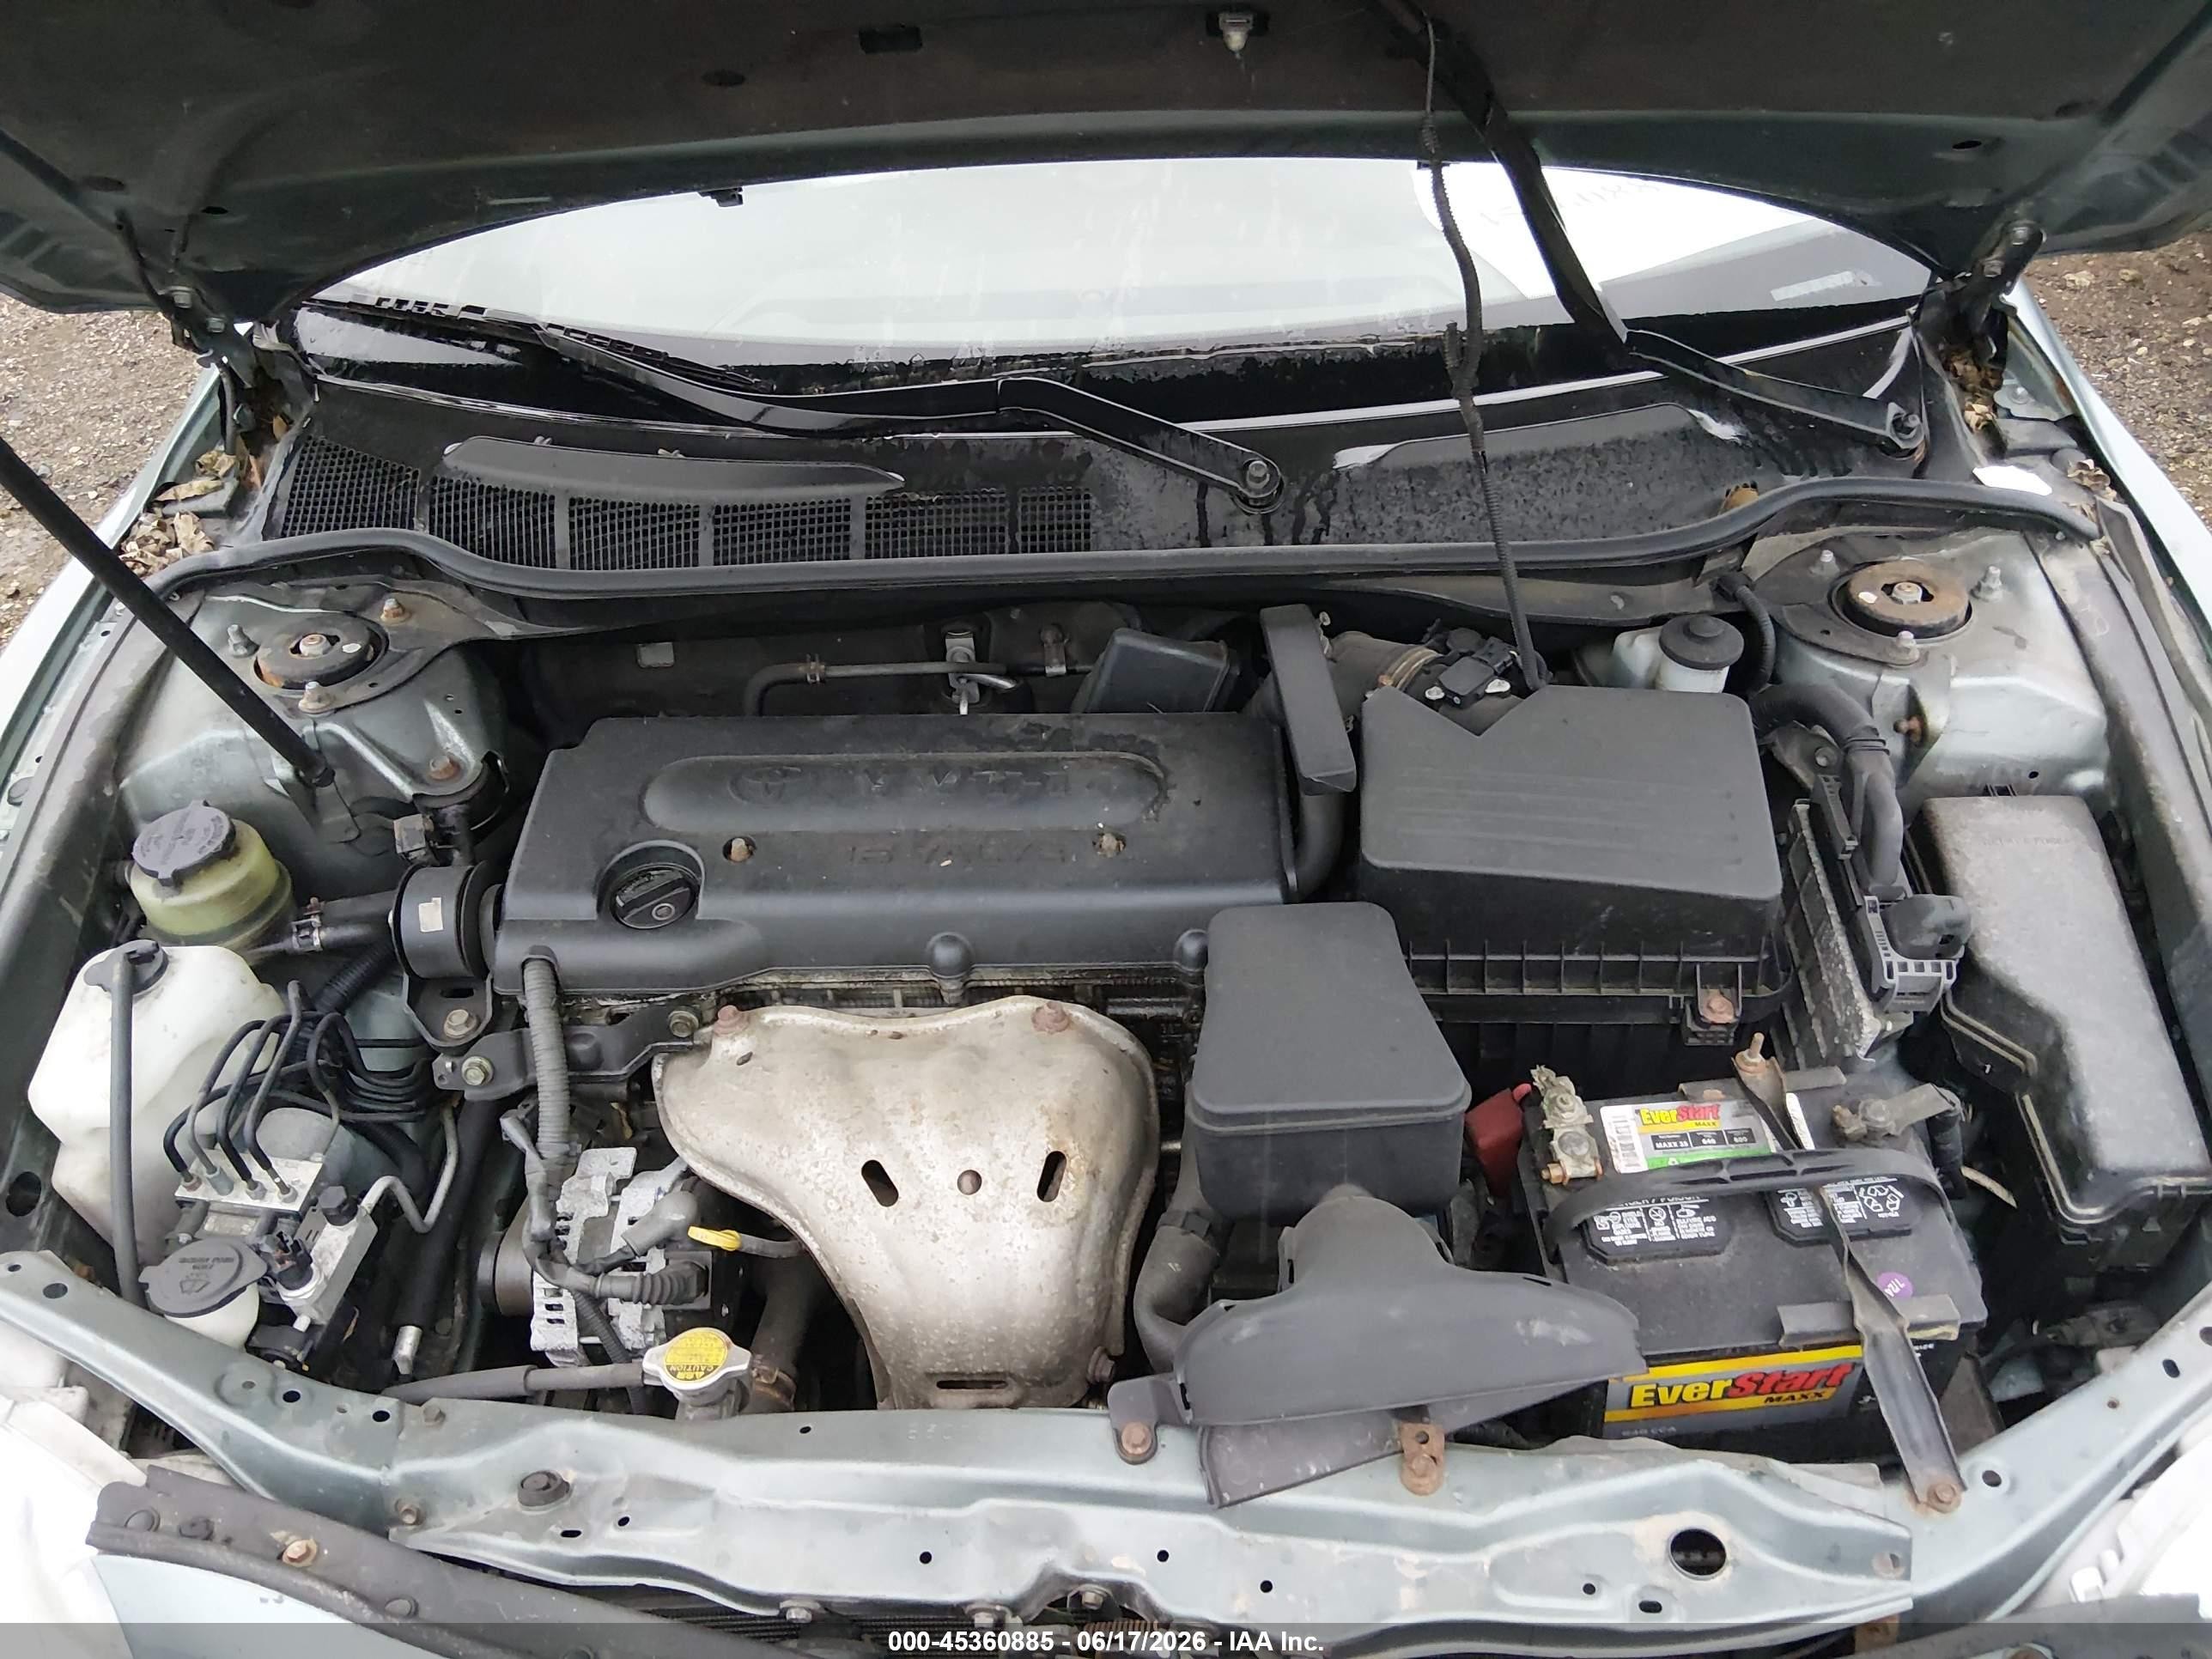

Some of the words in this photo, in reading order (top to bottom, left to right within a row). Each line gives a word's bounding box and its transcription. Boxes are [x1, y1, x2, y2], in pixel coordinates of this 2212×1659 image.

[1639, 1103, 1721, 1126] EverStart
[1629, 1362, 1855, 1408] EverStart
[1763, 1391, 1827, 1403] MAXX
